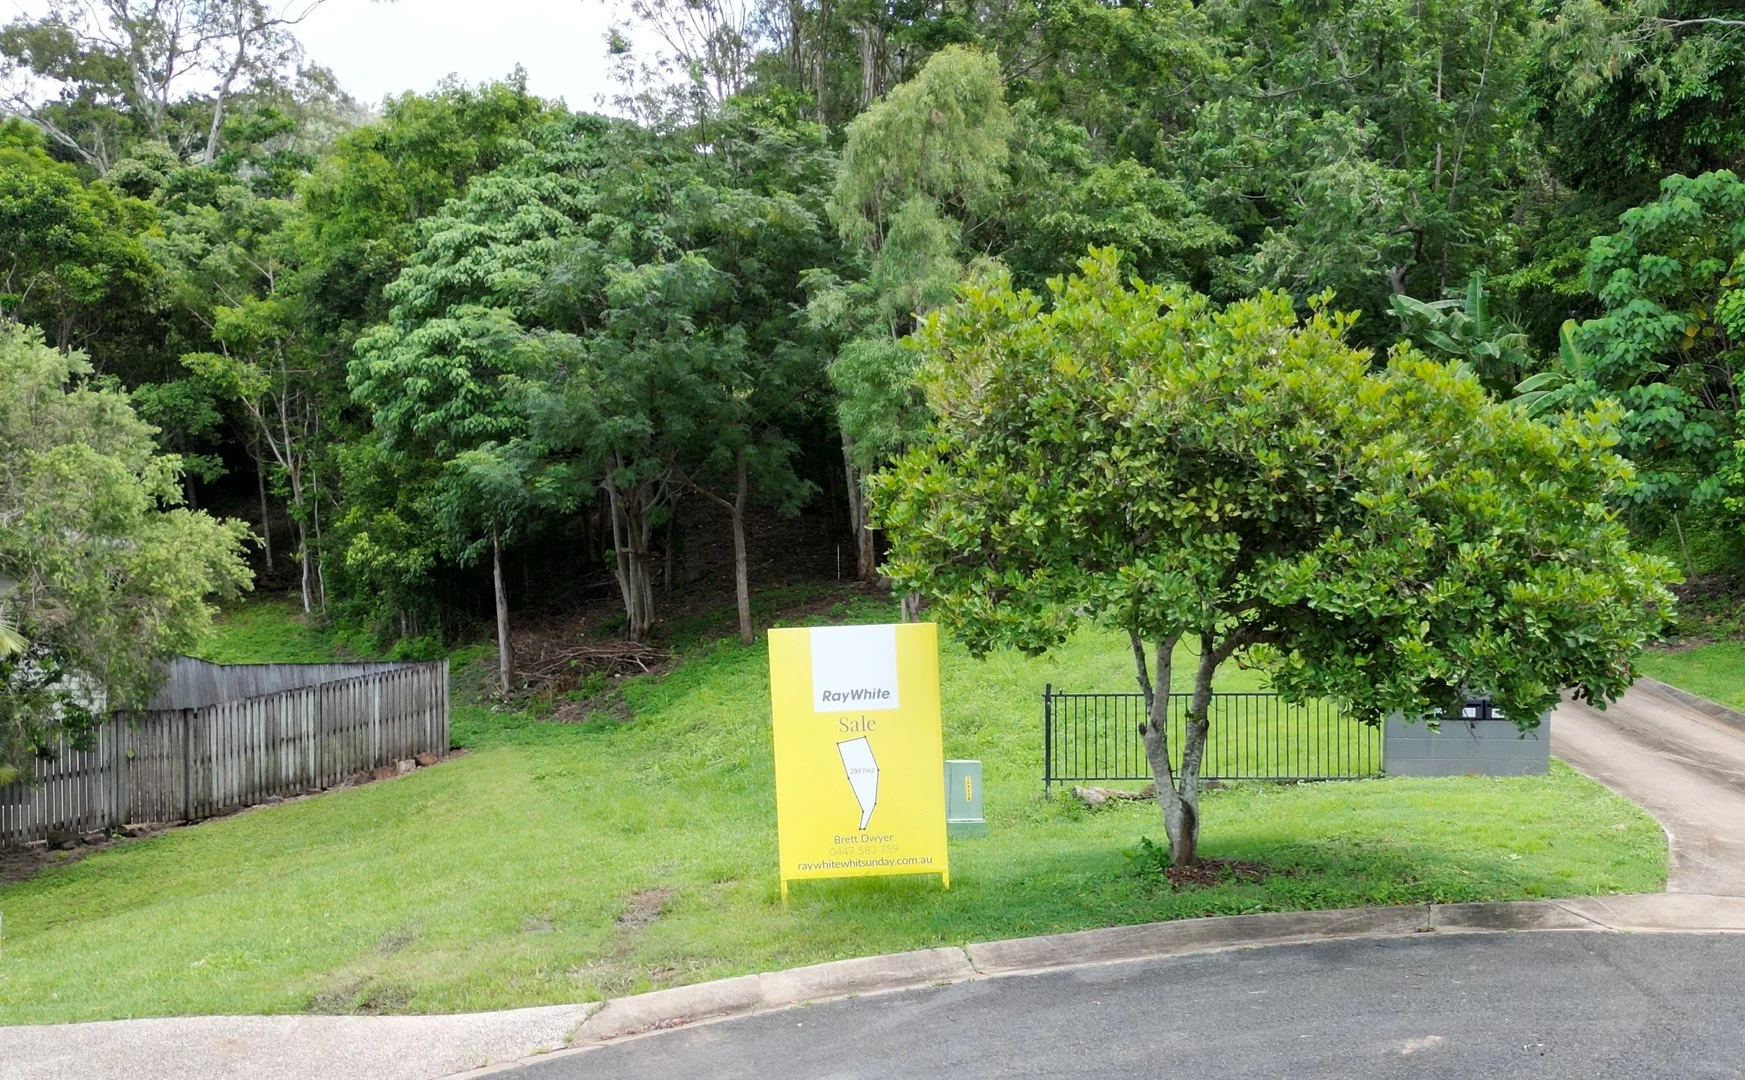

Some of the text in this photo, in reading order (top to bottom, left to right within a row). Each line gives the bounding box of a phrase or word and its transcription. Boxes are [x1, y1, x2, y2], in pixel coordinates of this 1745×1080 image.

[822, 688, 891, 703] RayWhite
[839, 715, 876, 733] Sale
[834, 834, 893, 845] Brett Dwyer
[829, 844, 898, 857] 0447 583 759
[797, 856, 933, 871] raywhitewhitsunday.com.au
